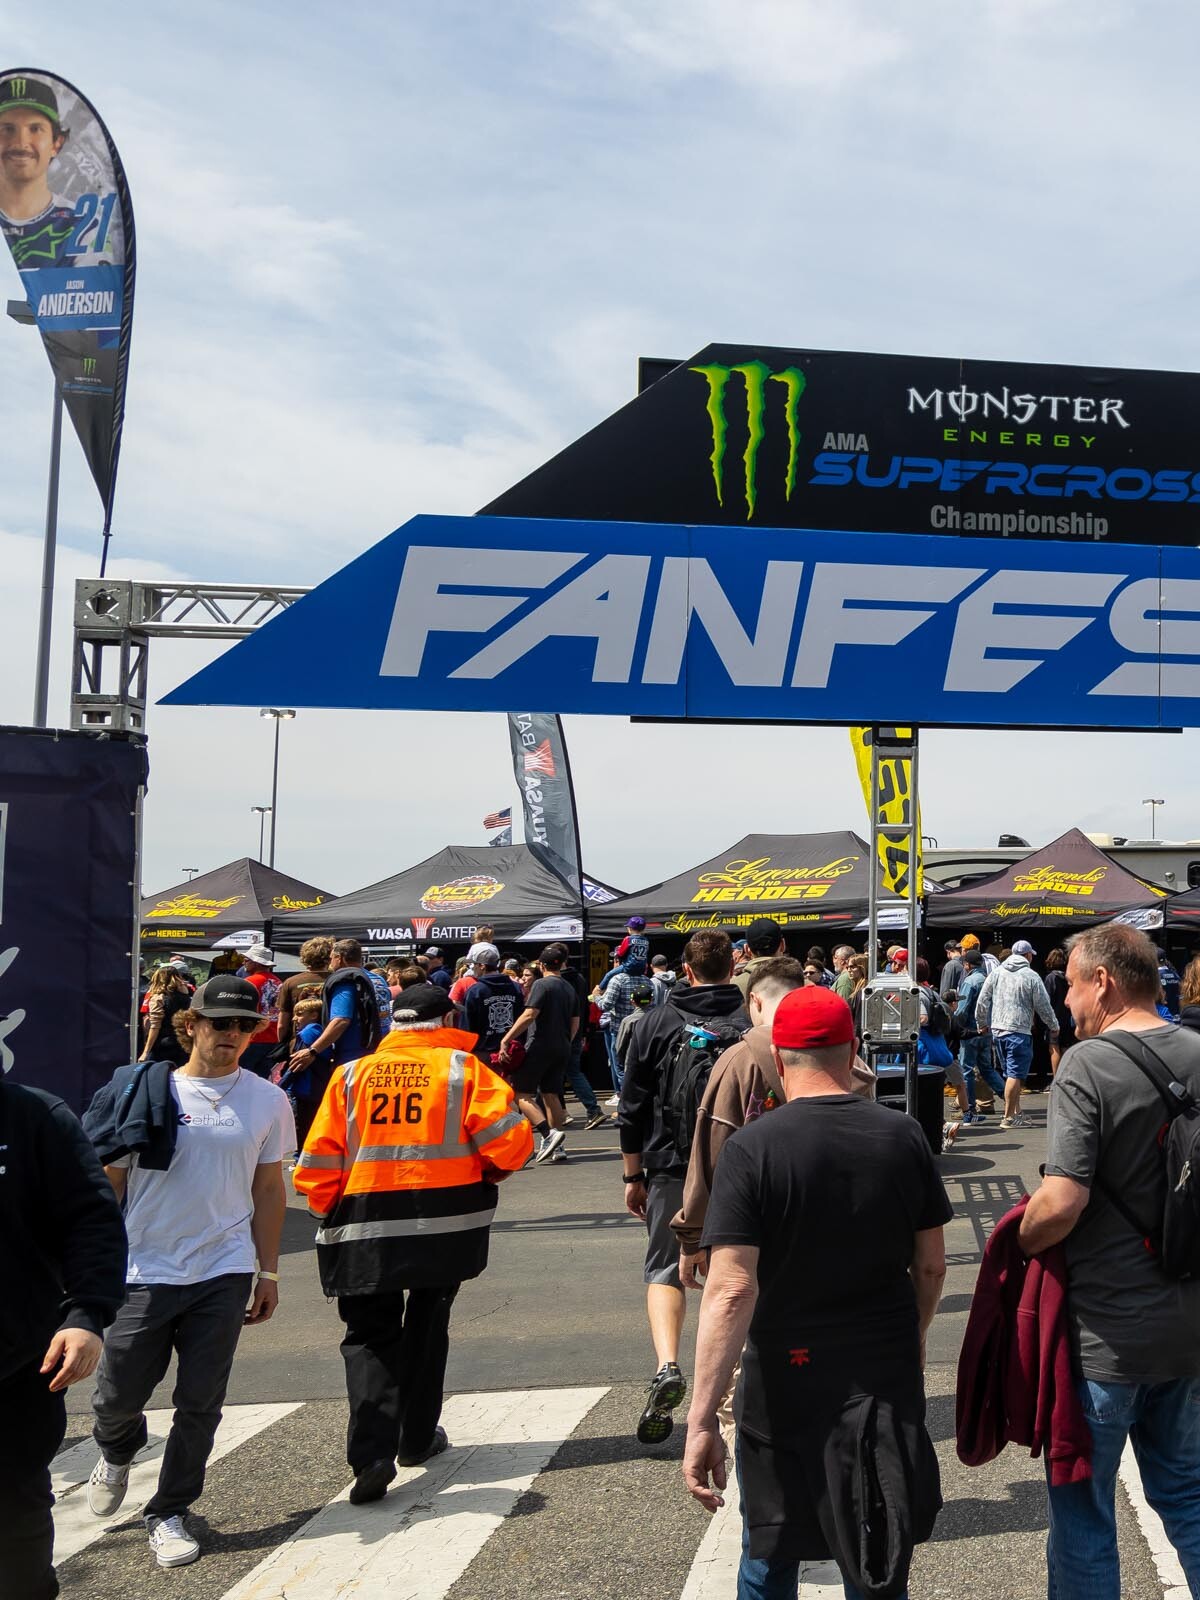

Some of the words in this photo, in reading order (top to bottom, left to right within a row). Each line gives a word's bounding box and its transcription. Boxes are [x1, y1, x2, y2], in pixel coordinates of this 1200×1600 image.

[65, 192, 118, 257] 21
[65, 280, 85, 290] JASON
[37, 290, 114, 317] ANDERSON
[907, 384, 1131, 429] MONSTER
[822, 431, 870, 452] AMA
[943, 428, 1097, 449] ENERGY
[930, 504, 1109, 540] Championship
[698, 856, 859, 888] Legends
[1013, 864, 1107, 884] Legends
[427, 883, 505, 895] MOTO
[690, 884, 834, 903] HEROES
[1013, 882, 1094, 895] HEROES
[272, 894, 324, 910] Legend
[990, 902, 1031, 918] Legends
[1039, 906, 1073, 916] HEROES
[664, 911, 722, 934] Legends
[156, 929, 187, 938] HEROES
[367, 928, 413, 940] YUASA
[431, 926, 477, 939] BATTER
[632, 946, 647, 960] 42
[375, 1063, 426, 1075] SAFETY
[368, 1075, 431, 1088] SERVICES
[370, 1092, 423, 1125] 216
